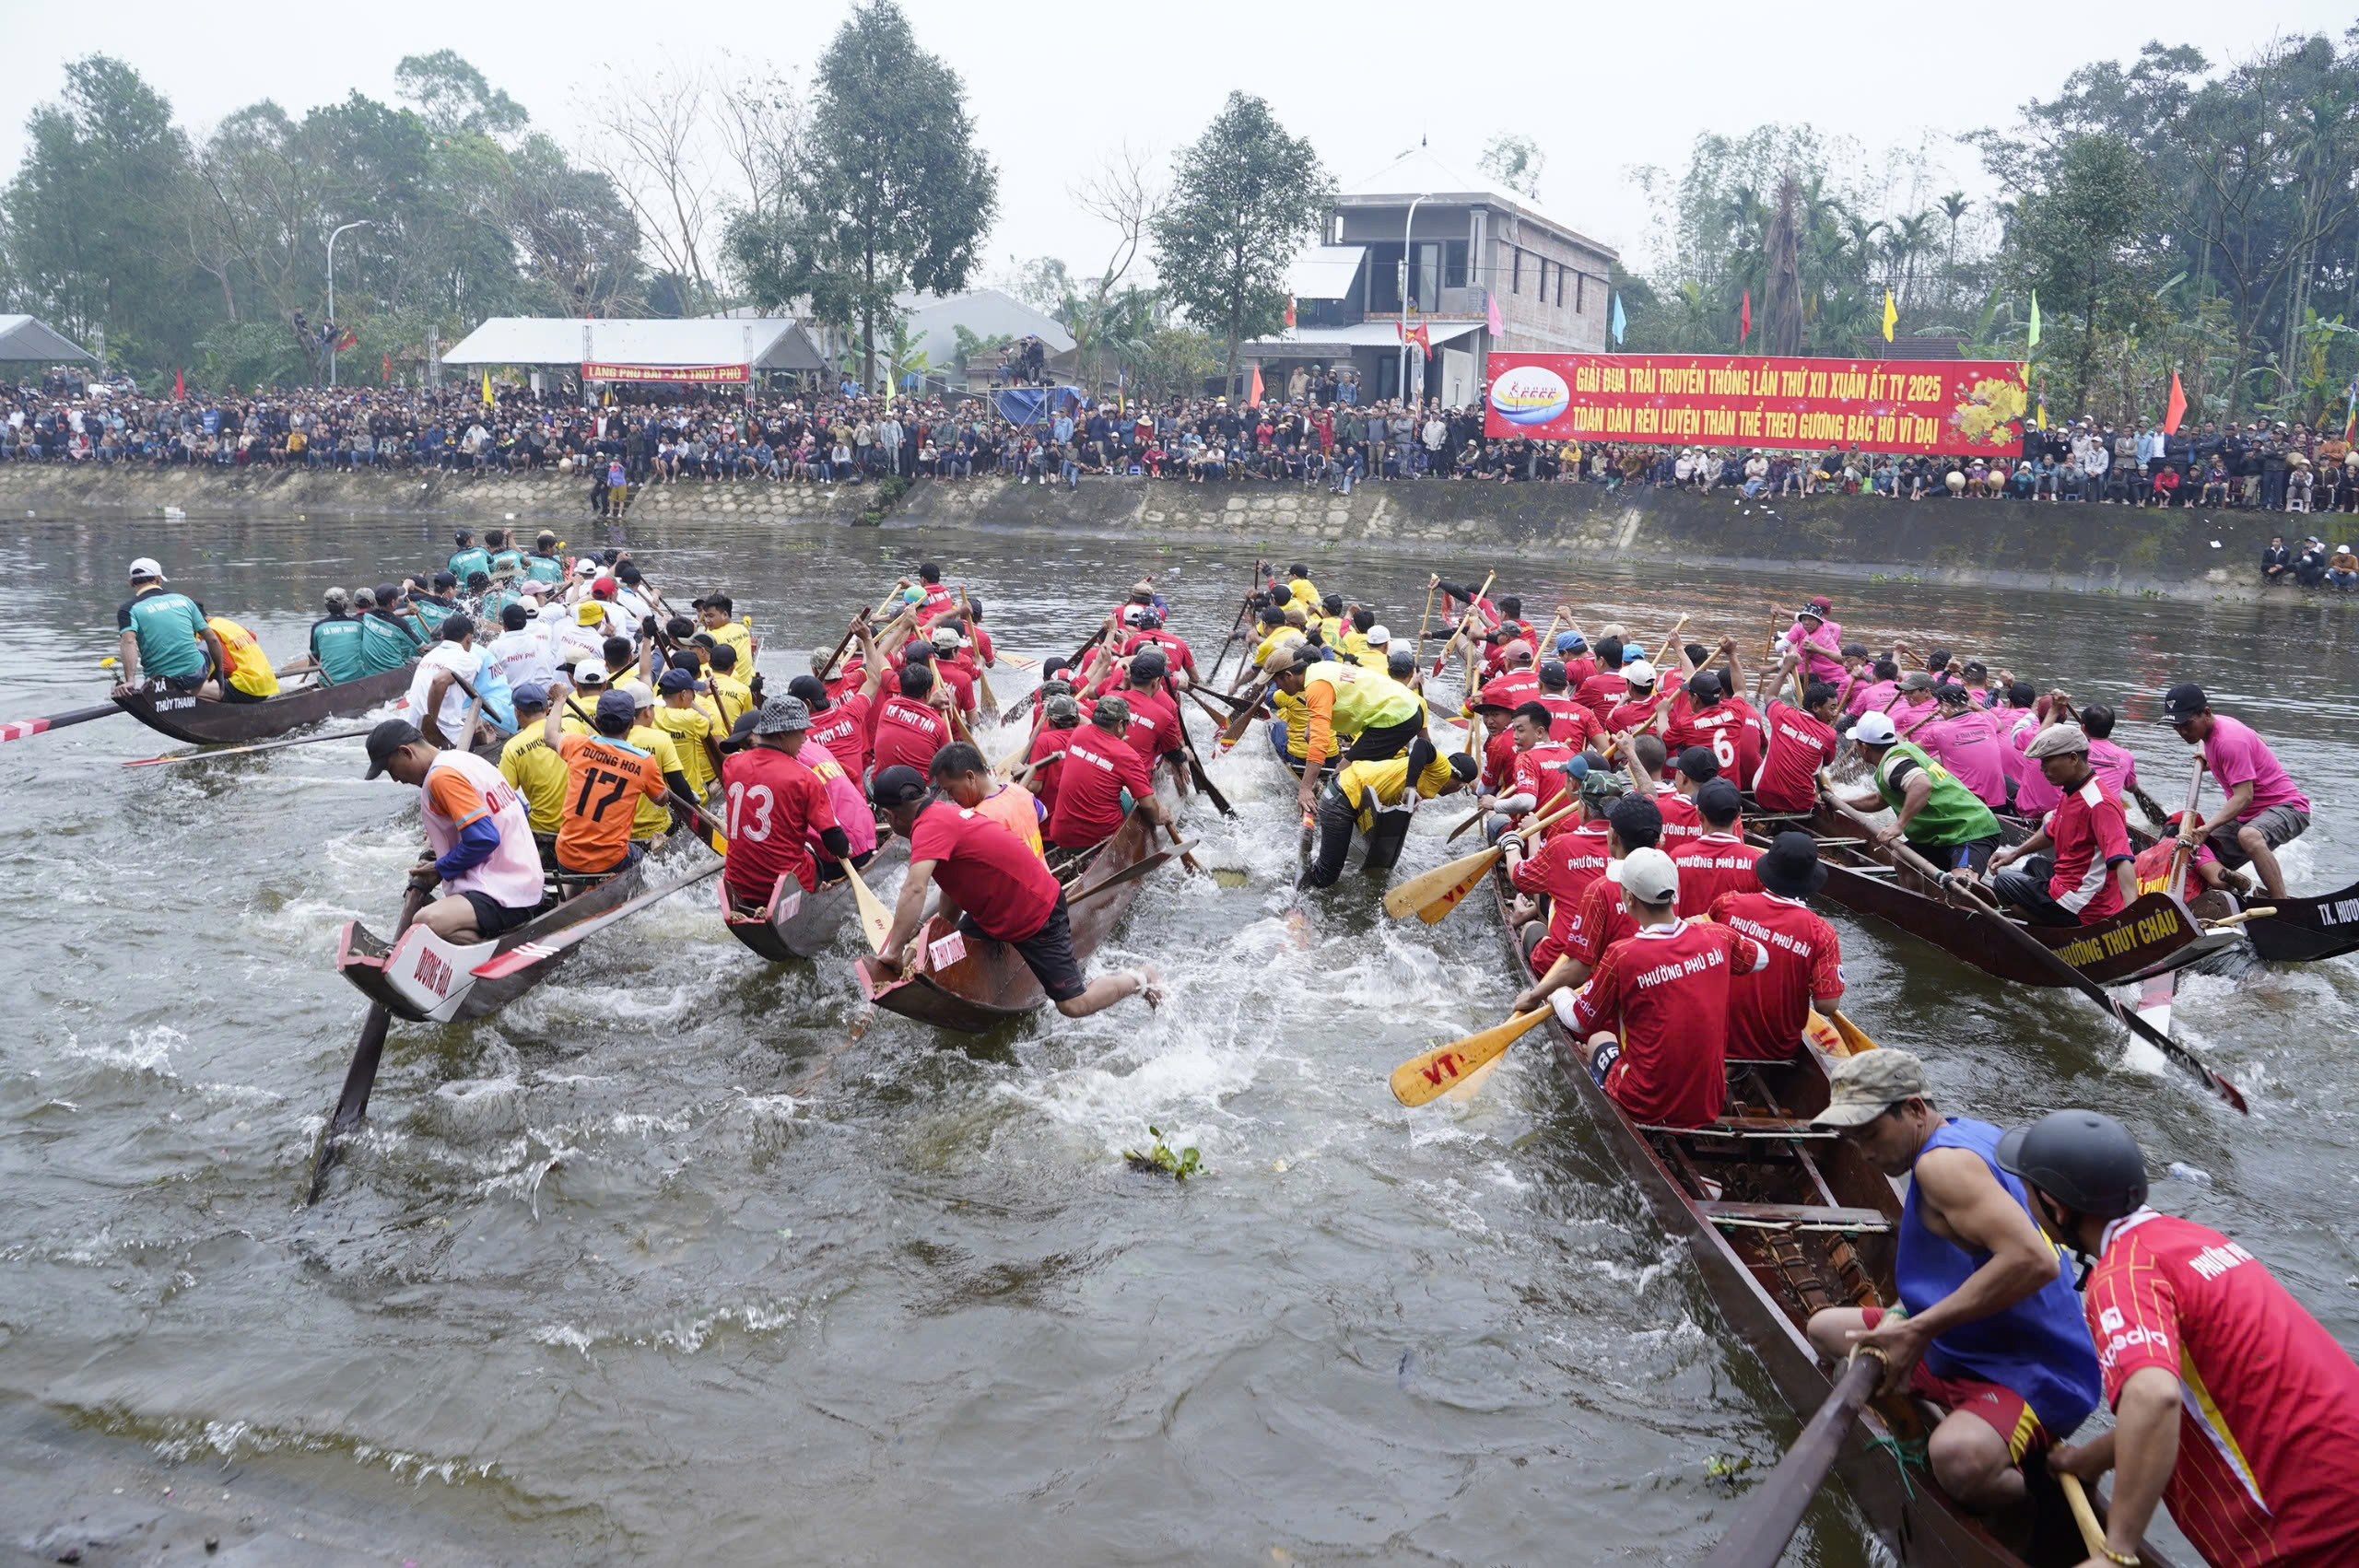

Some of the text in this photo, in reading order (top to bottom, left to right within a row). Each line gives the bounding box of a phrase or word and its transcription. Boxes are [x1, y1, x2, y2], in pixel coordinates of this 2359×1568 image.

[1577, 359, 1942, 406] GIẢI ĐUA TRẢI TRUYỀN THỐNG LẦN THỨ XII XUÂN ẤT TỴ 2025
[1573, 402, 1604, 432] TOÀN
[1606, 403, 1632, 433] DÂN
[1661, 404, 1700, 440] LUYỆN
[1704, 405, 1736, 436] THÂN
[1739, 401, 1764, 437] THỂ
[1766, 412, 1796, 439] THEO
[1799, 411, 1844, 440] GƯƠNG
[1847, 410, 1873, 441] BÁC
[1877, 407, 1896, 443] HỒ
[1899, 412, 1913, 443] VĨ
[1915, 416, 1940, 451] ĐẠI
[174, 696, 195, 709] THANH
[582, 746, 642, 776] DƯƠNG HÒA
[1713, 728, 1734, 767] 6
[575, 766, 628, 823] 17
[728, 781, 774, 842] 13
[1567, 855, 1604, 870] PHƯỜNG
[1676, 855, 1714, 869] PHƯỜNG
[1736, 857, 1753, 871] BÀI
[2101, 920, 2138, 956] THỦY
[2138, 908, 2179, 944] CHÂU
[2318, 904, 2337, 926] TX.
[1729, 915, 1771, 942] PHƯỜNG
[1792, 941, 1812, 958] BÀI
[1637, 963, 1684, 989] PHƯỜNG
[1707, 947, 1724, 966] BÀI
